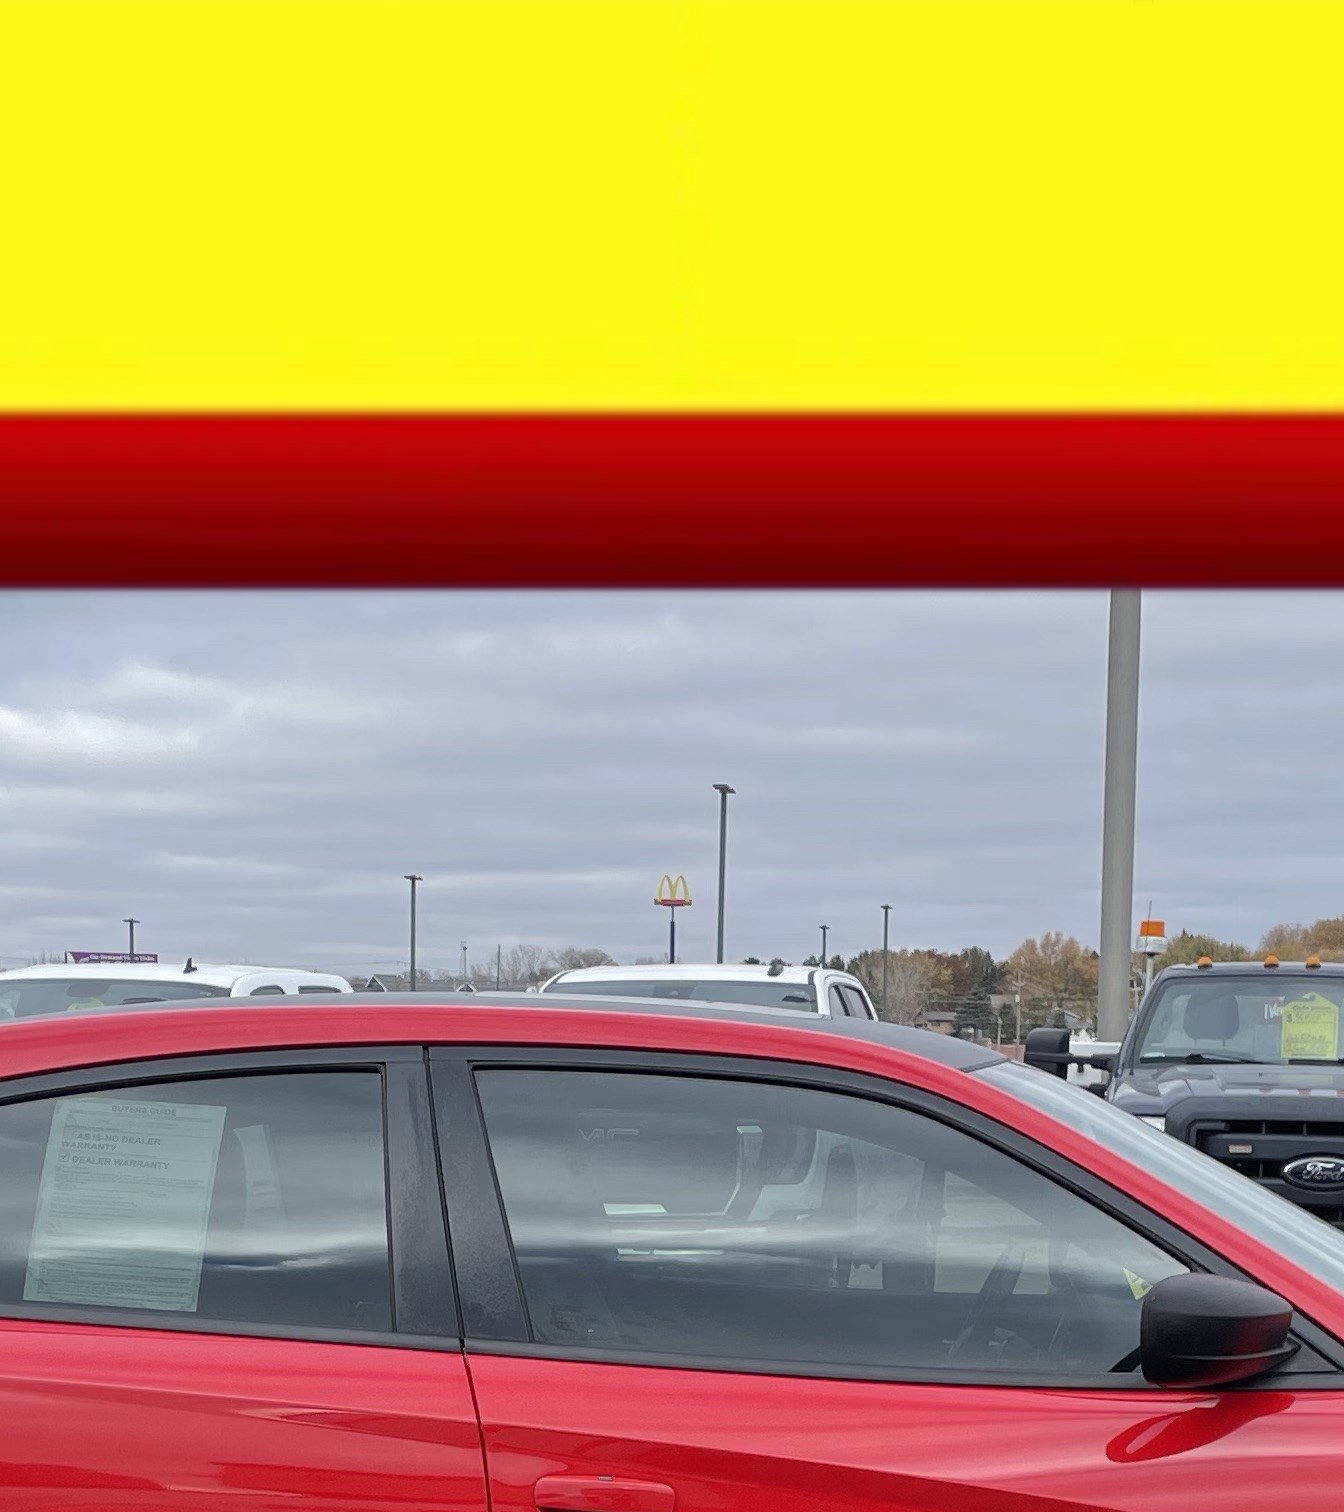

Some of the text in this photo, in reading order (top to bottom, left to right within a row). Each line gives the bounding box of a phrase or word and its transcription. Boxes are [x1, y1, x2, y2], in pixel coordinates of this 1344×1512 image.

[61, 1141, 116, 1151] WARRANTY
[121, 1136, 161, 1146] DEALER
[71, 1155, 169, 1170] DEALER WARRANTY
[1302, 1162, 1344, 1181] Ford
